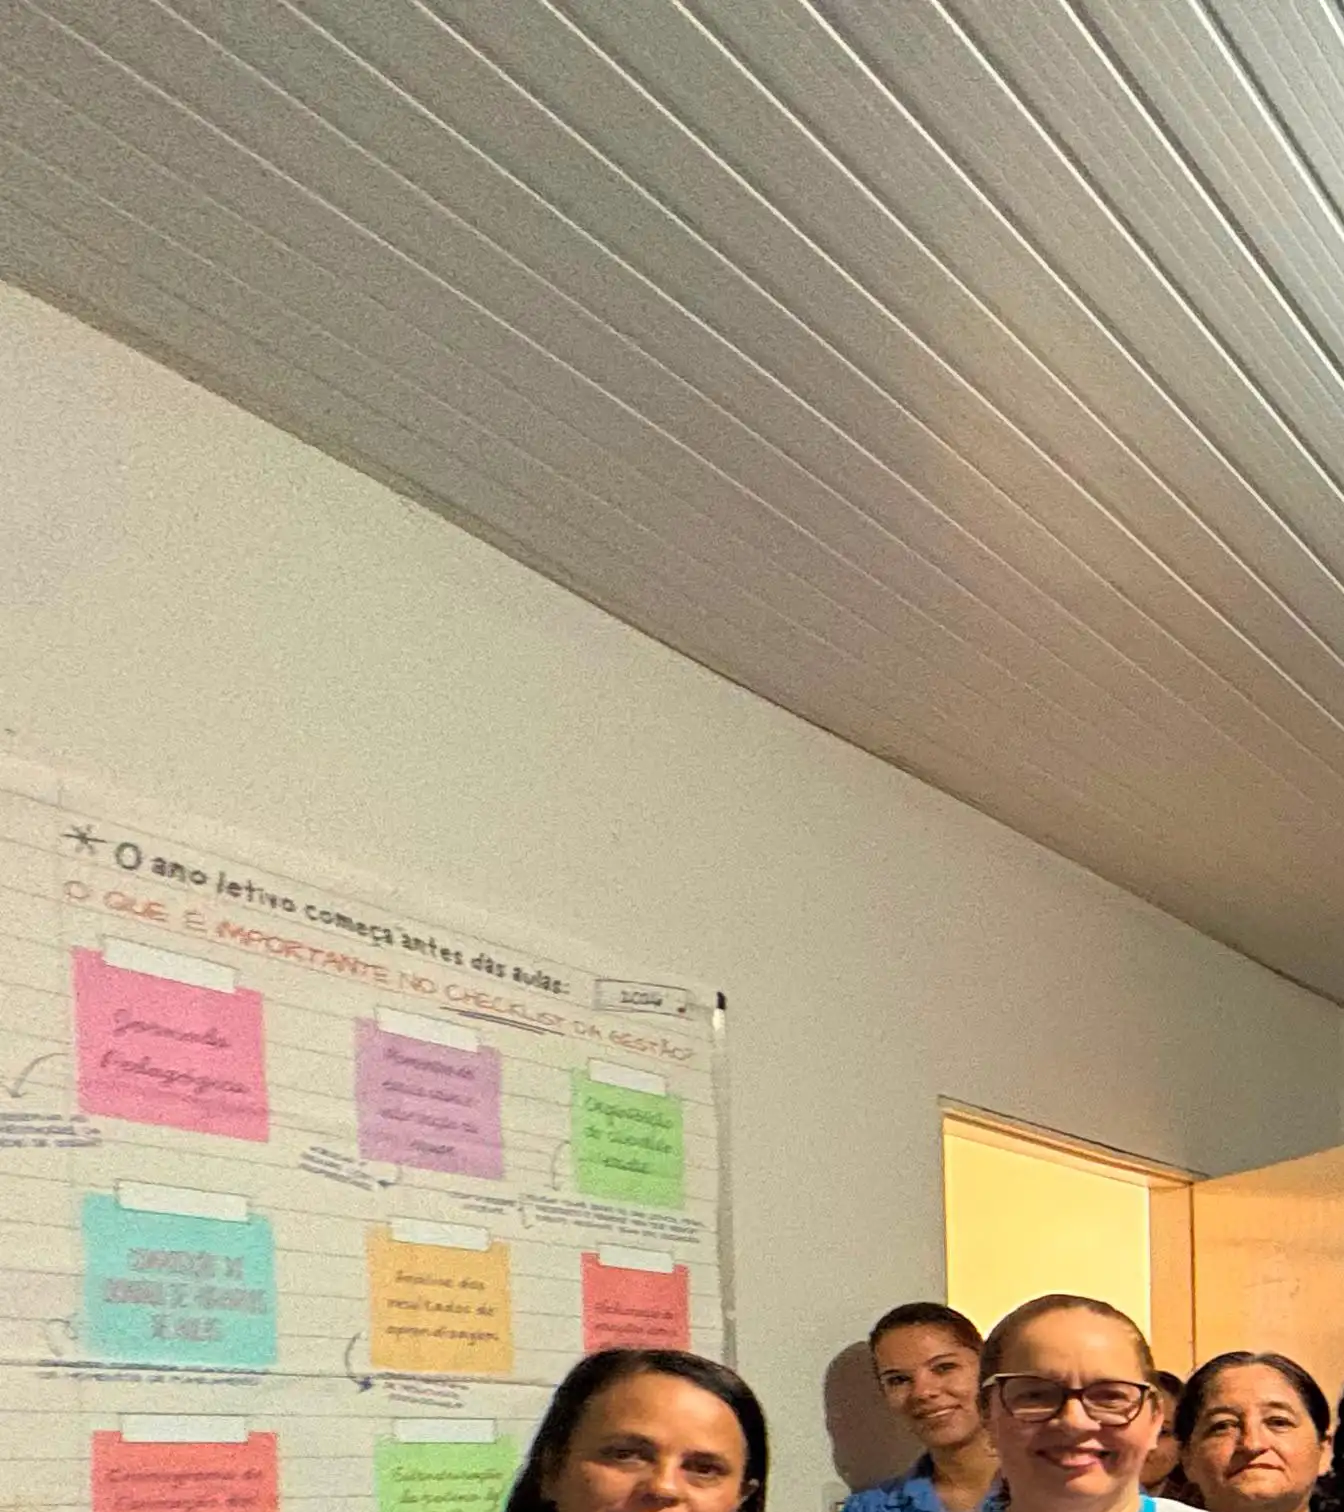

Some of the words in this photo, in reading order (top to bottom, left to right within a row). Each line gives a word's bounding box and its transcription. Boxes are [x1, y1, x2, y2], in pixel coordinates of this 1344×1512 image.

[62, 880, 91, 901] O
[103, 890, 170, 923] QUE
[217, 919, 390, 983] IMPORTANTE
[401, 972, 437, 994] NO
[114, 842, 143, 870] O
[150, 855, 208, 886] ano
[216, 871, 296, 913] letivo
[304, 902, 393, 947] começa
[401, 933, 463, 965] antes
